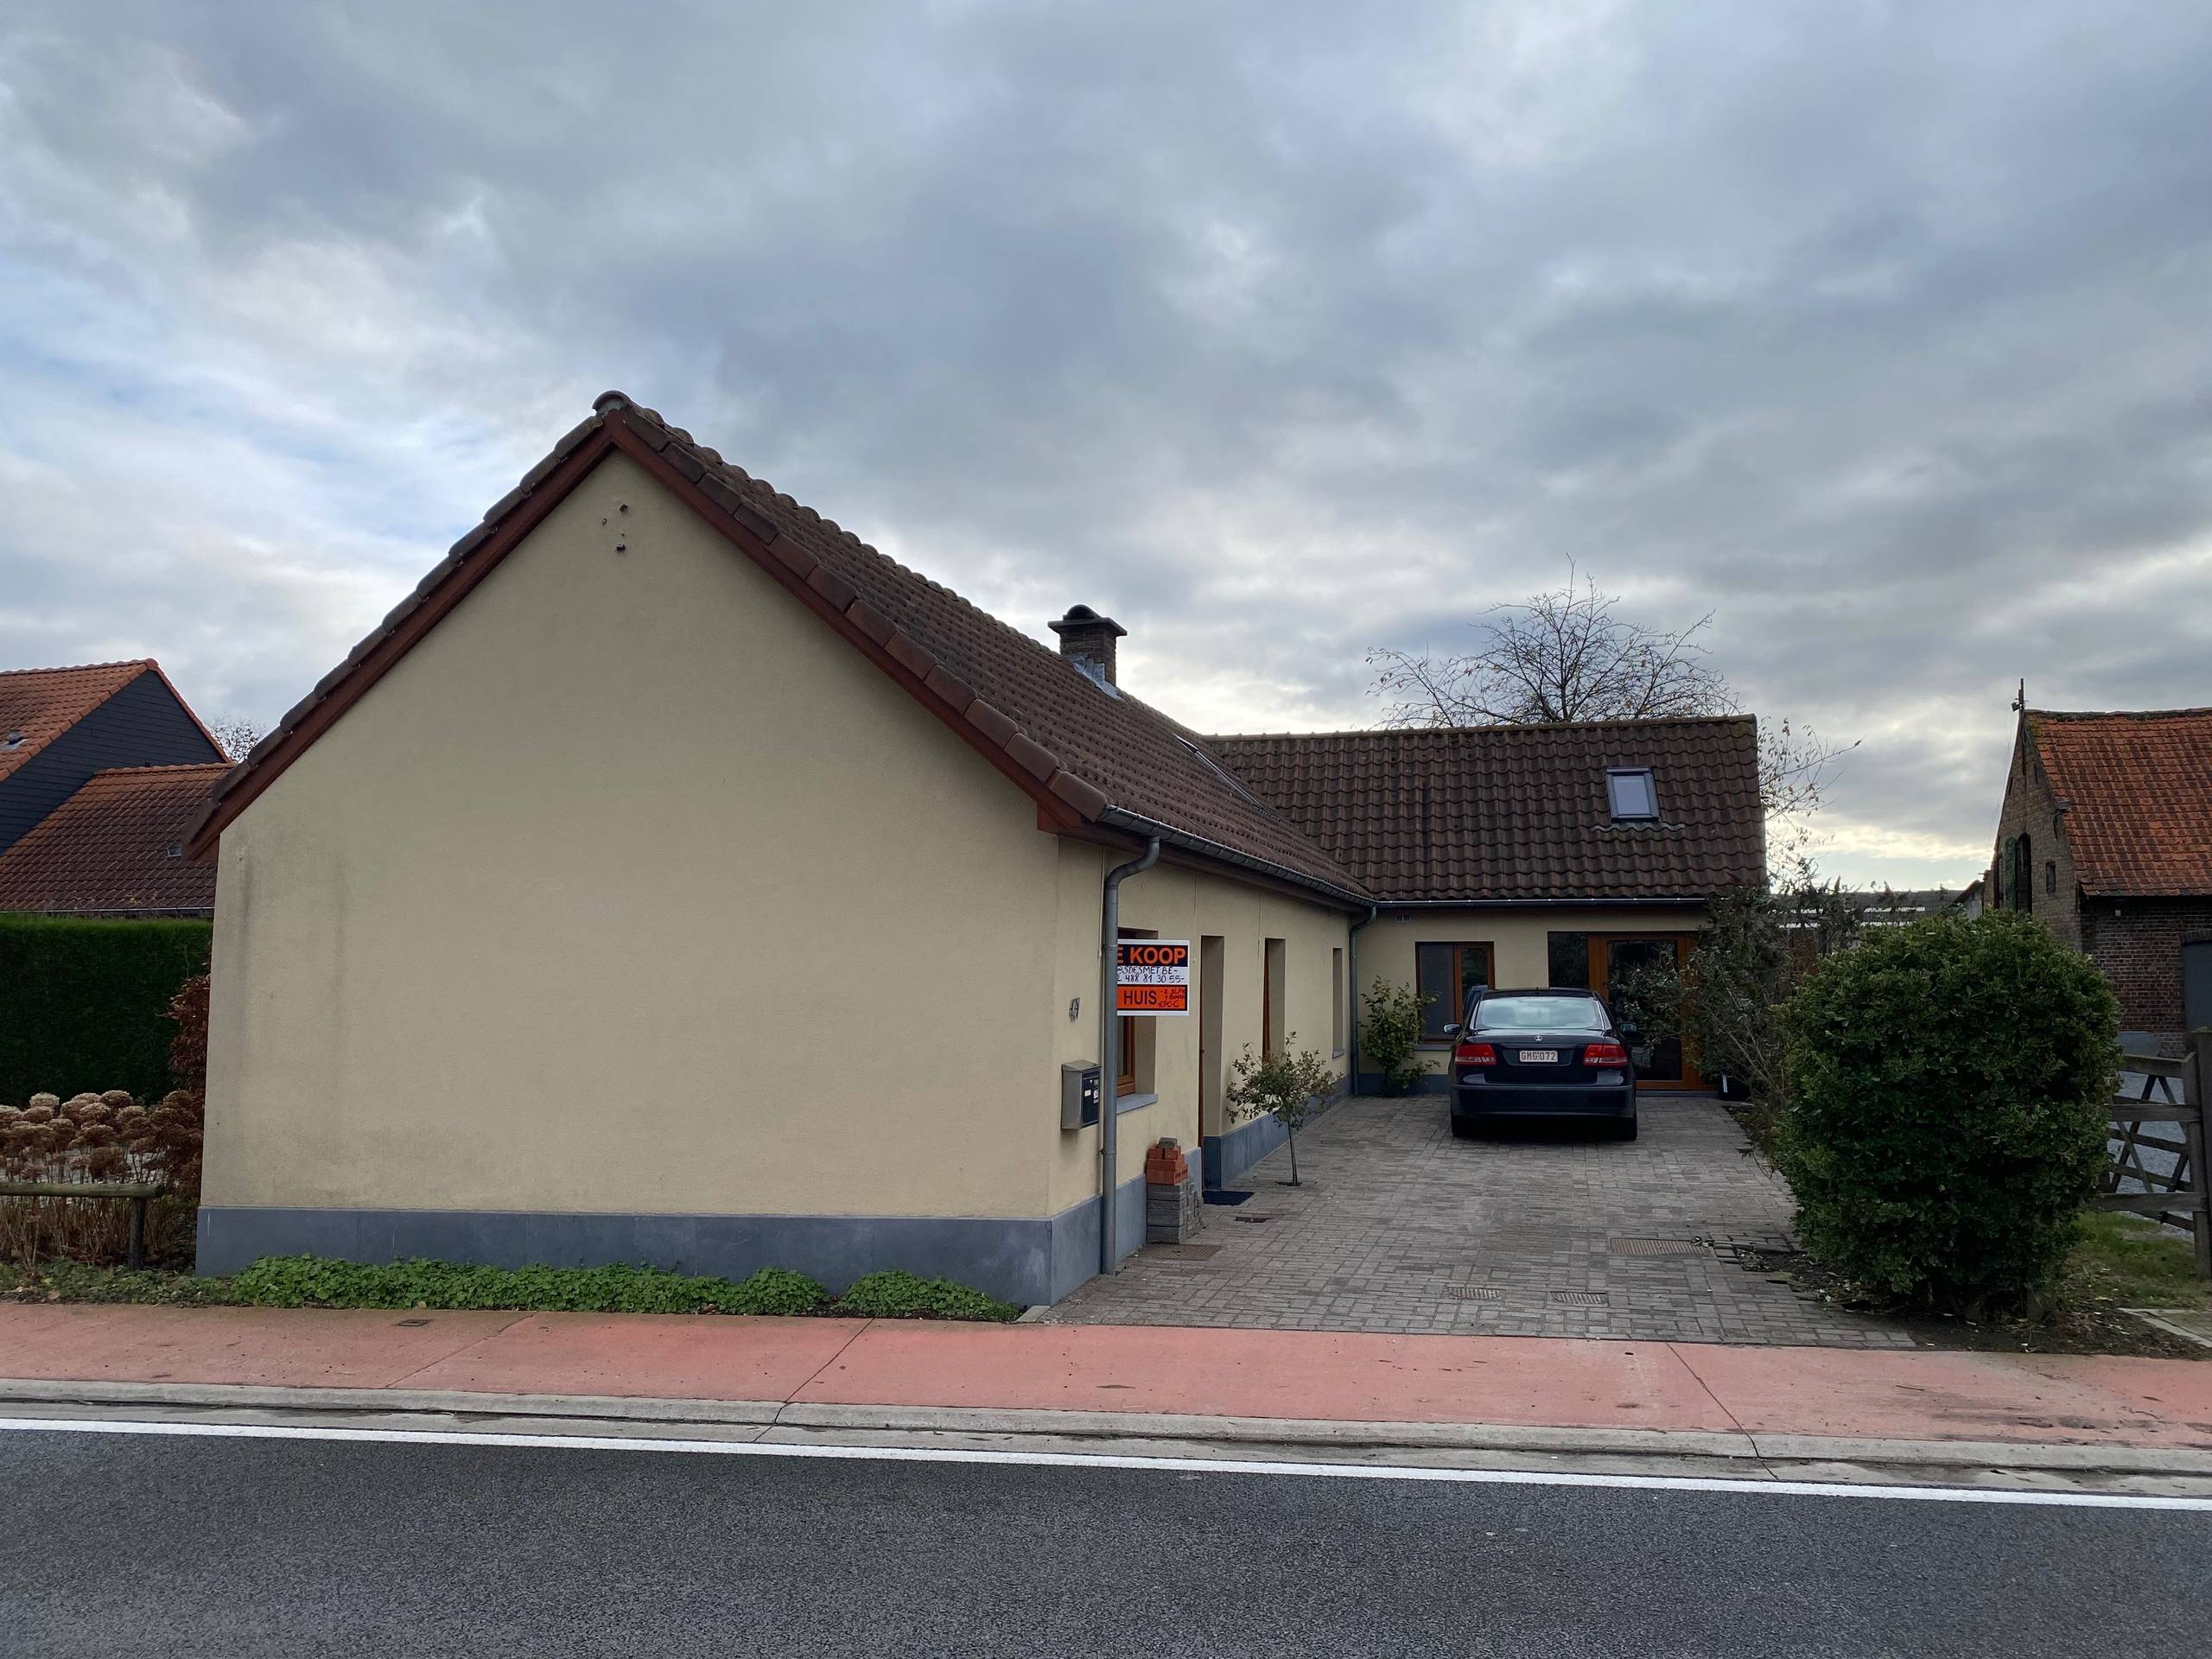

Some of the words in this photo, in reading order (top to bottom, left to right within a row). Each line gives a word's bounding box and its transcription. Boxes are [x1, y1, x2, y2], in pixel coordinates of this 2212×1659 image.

[1130, 947, 1185, 964] KOOP
[1157, 975, 1167, 983] 30
[1123, 989, 1158, 1005] HUIS
